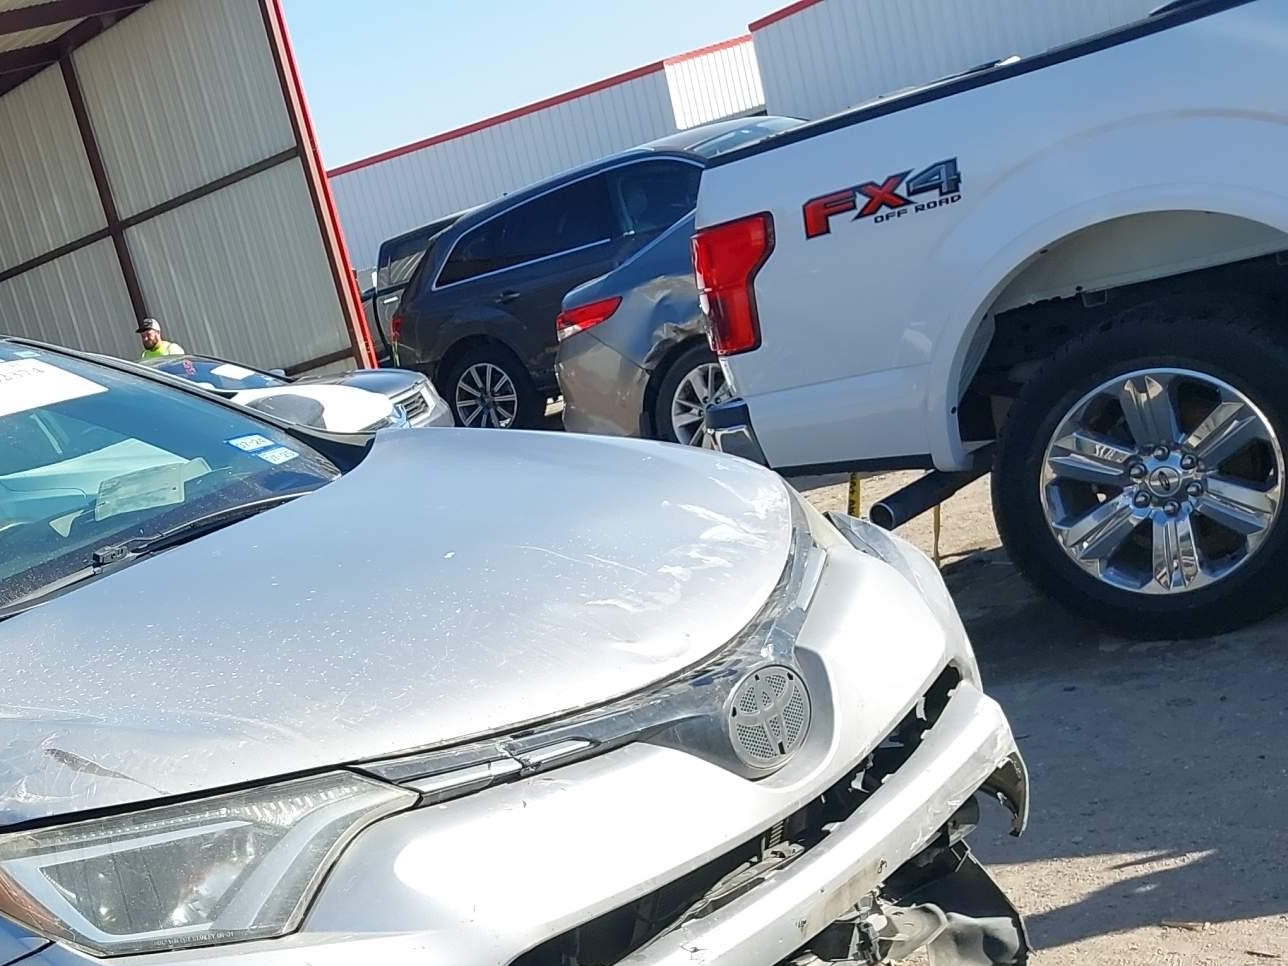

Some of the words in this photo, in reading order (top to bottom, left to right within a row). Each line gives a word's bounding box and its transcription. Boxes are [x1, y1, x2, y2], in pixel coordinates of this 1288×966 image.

[802, 156, 961, 240] FX4
[873, 208, 909, 224] OFF
[914, 194, 962, 214] ROAD
